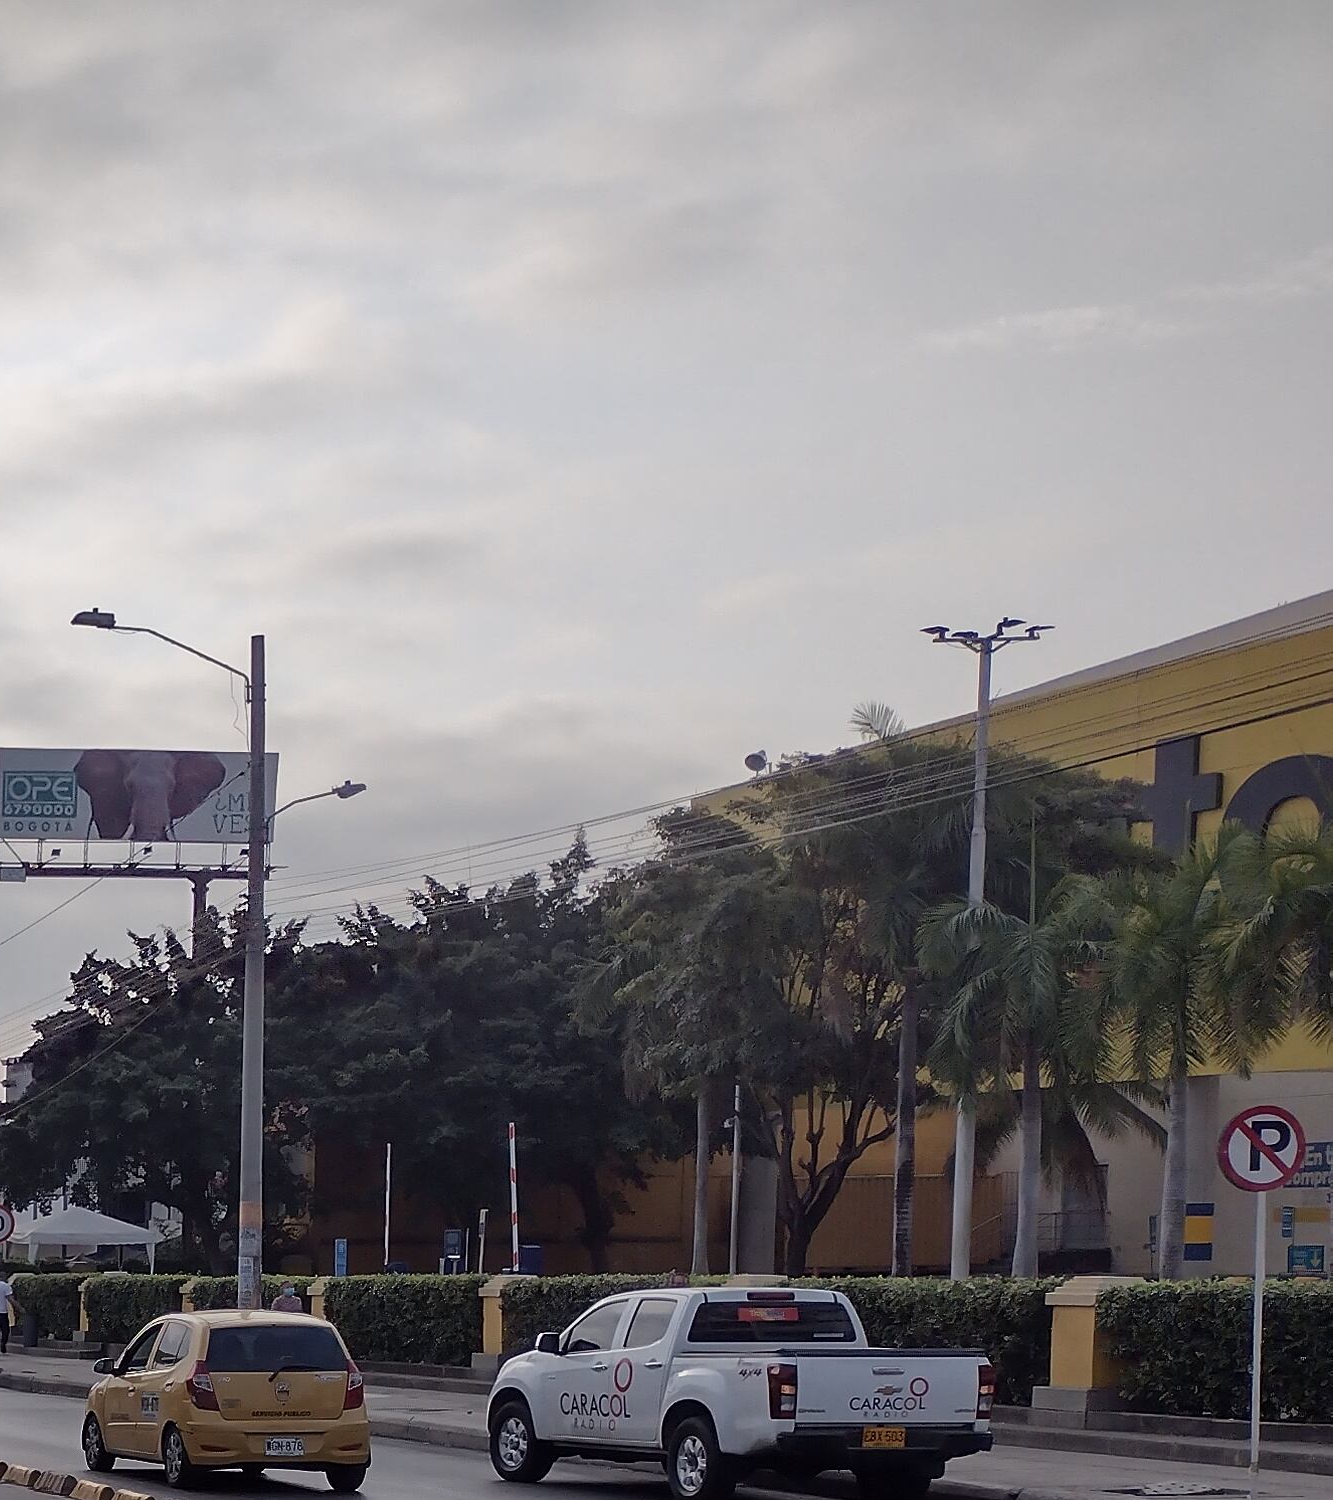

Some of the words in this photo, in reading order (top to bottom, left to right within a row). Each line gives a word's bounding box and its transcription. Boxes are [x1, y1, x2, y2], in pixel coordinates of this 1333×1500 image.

[8, 777, 72, 801] OPE
[4, 803, 74, 816] 6790000
[560, 1392, 631, 1419] CARACOL
[849, 1396, 926, 1411] CARACOL
[863, 1410, 909, 1418] RADIO
[573, 1418, 616, 1432] RADIO
